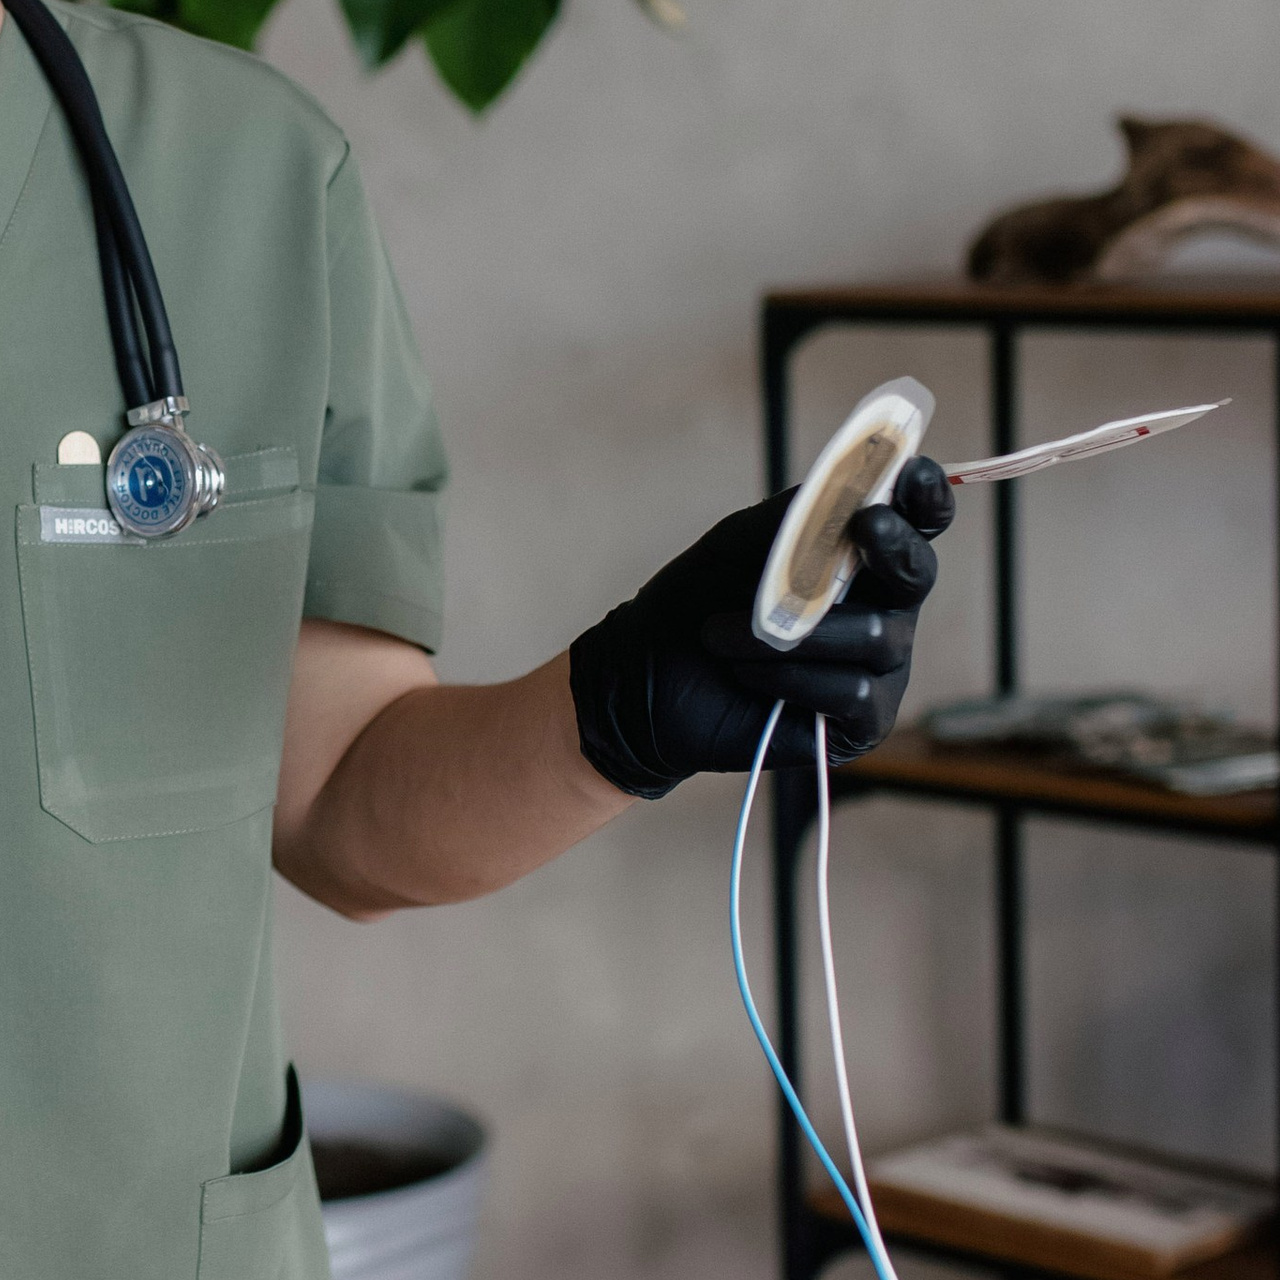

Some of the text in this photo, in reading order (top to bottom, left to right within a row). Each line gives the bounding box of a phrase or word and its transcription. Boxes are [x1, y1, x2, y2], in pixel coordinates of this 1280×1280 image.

[122, 442, 168, 466] QUALITY
[117, 471, 183, 520] LITTLE DOCTOR
